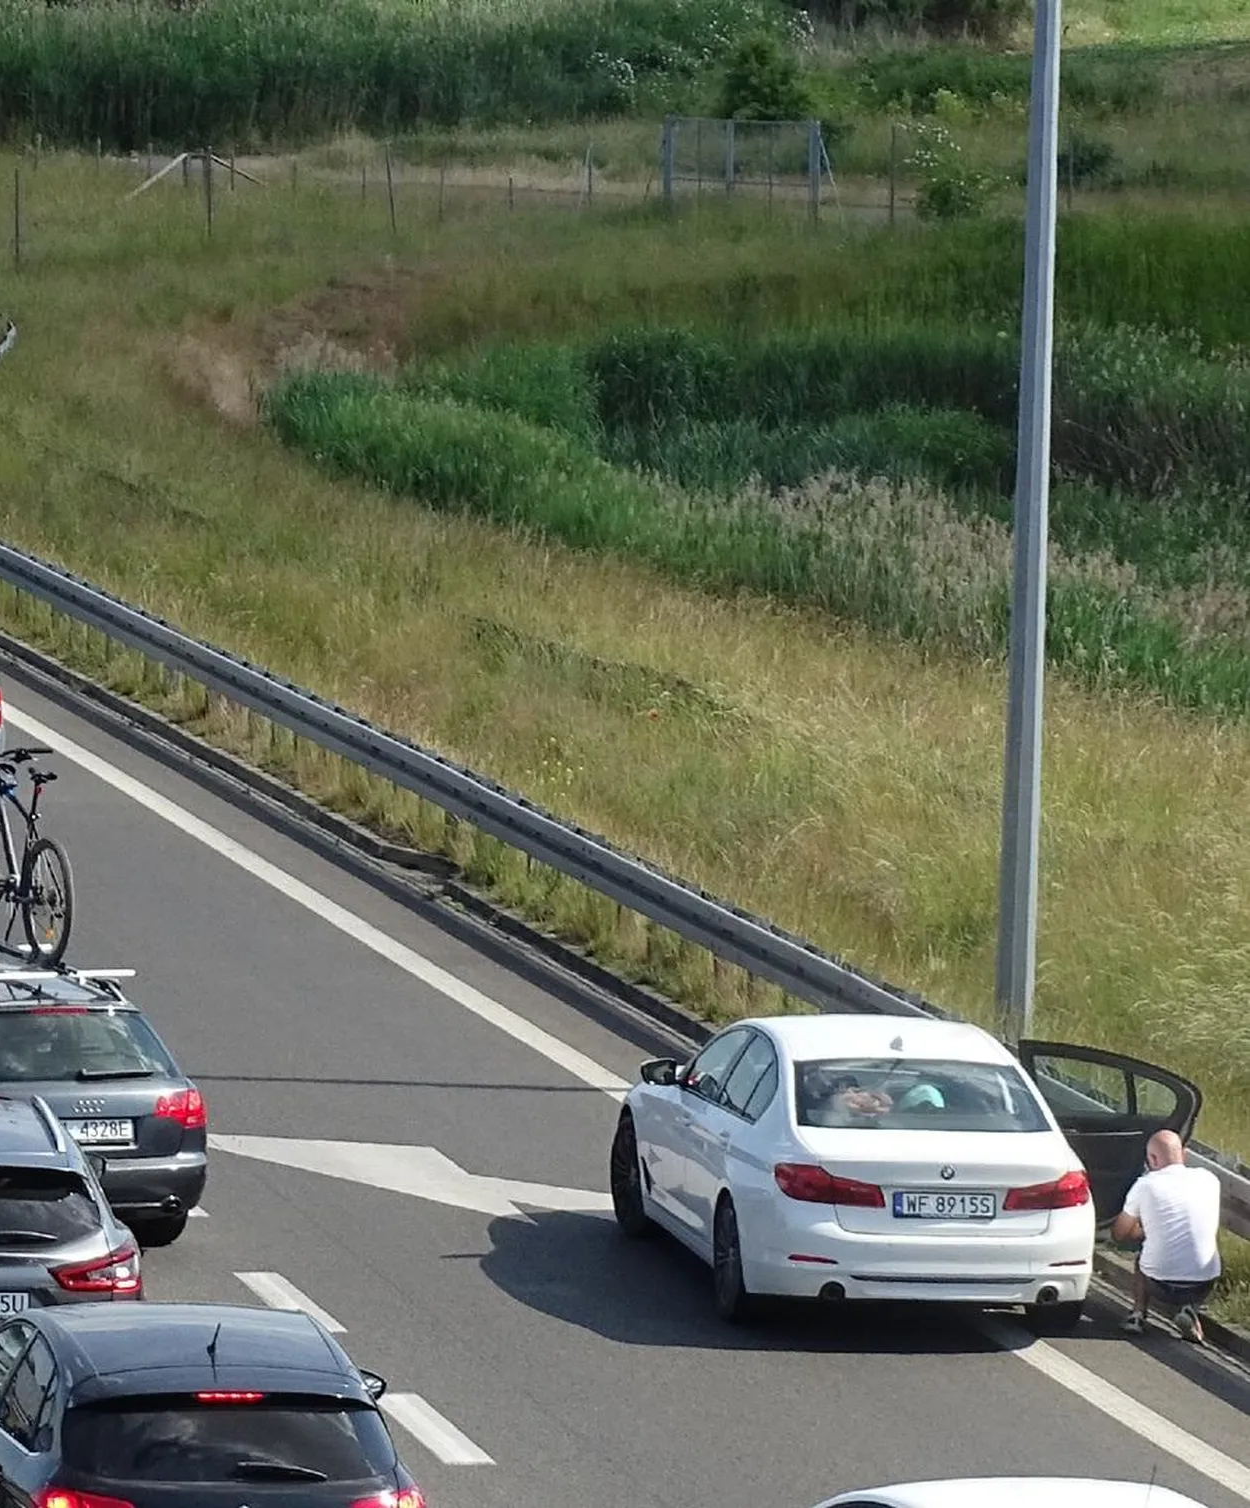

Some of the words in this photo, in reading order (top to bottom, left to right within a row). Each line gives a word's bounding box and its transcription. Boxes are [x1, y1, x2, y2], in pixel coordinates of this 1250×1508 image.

[80, 1121, 129, 1138] 4328E
[905, 1195, 929, 1212] WF
[935, 1196, 991, 1213] 8915S
